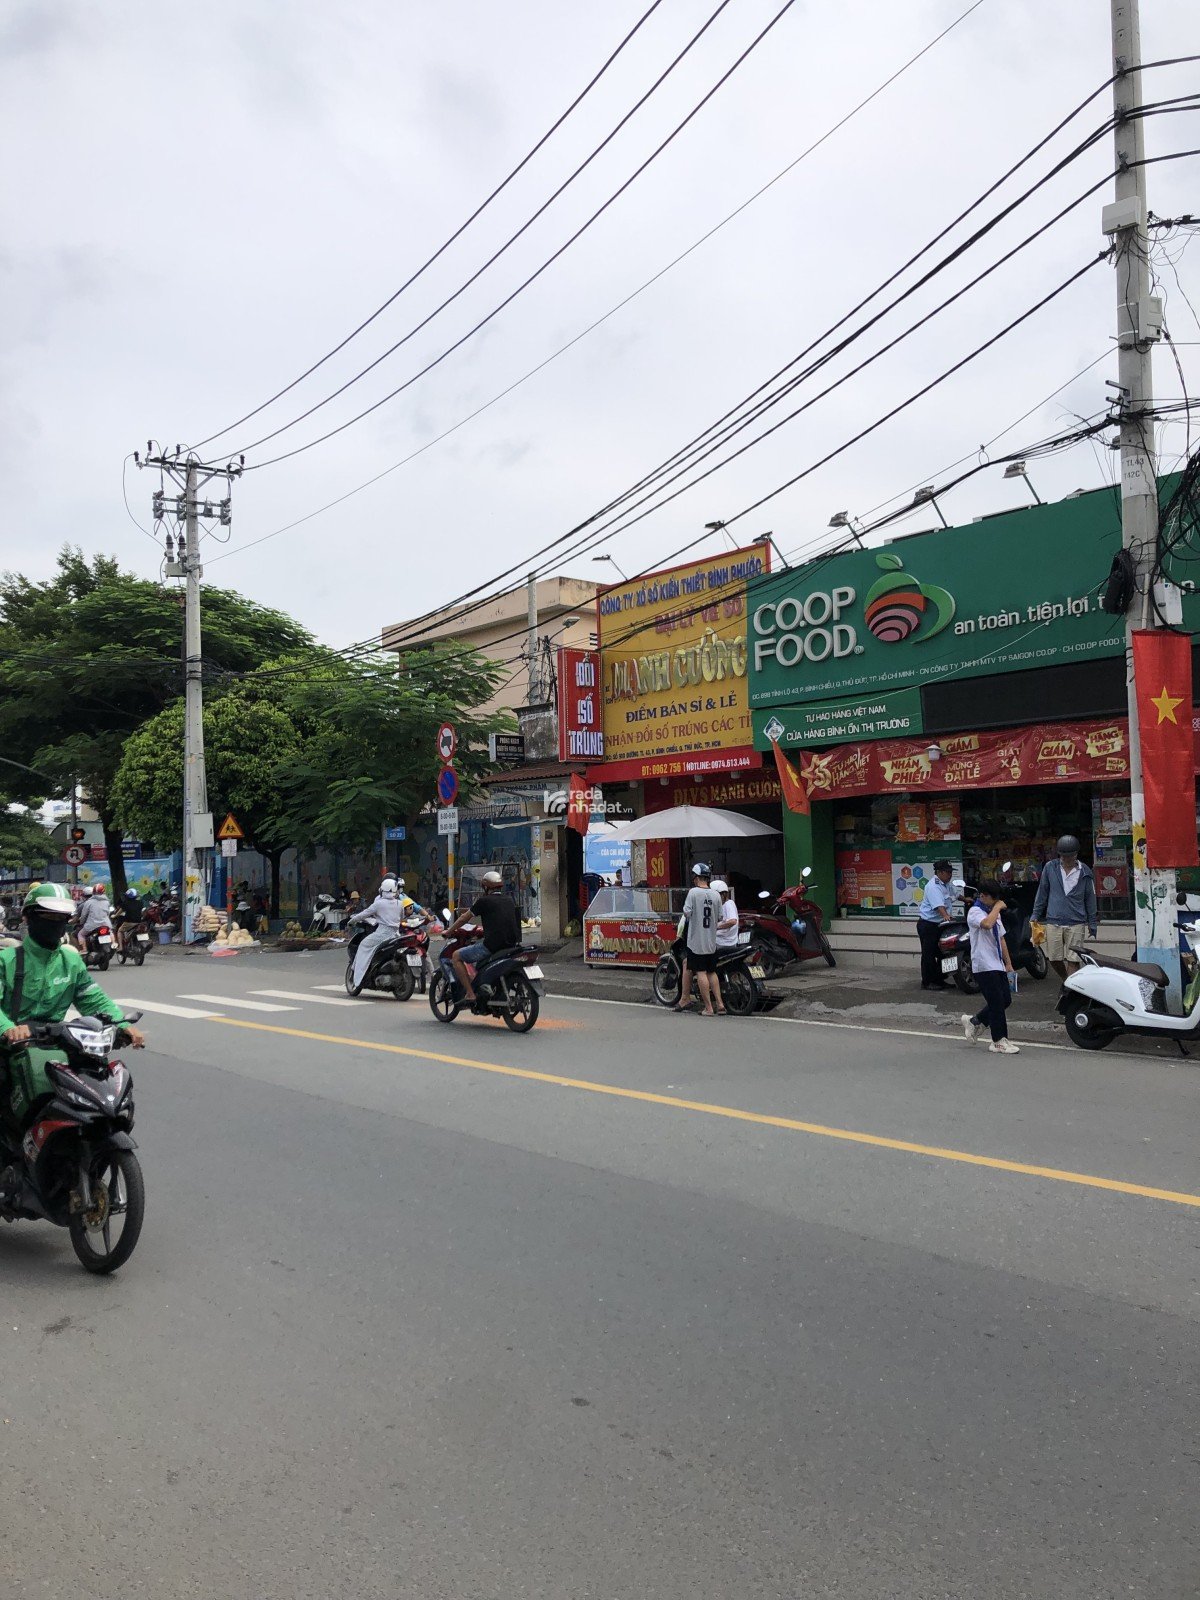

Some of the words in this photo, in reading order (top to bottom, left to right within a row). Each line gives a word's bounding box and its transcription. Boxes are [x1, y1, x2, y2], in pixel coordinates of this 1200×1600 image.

[600, 595, 621, 616] CÔNG
[623, 593, 634, 610] TY
[636, 580, 647, 606] XỔ
[648, 578, 660, 603] SỐ
[660, 575, 680, 600] KIẾN
[681, 568, 706, 593] THIẾT
[708, 566, 728, 588] BÌNH
[731, 555, 763, 580] PHƯỚC
[753, 586, 856, 636] CO.OP
[955, 620, 974, 635] an
[1027, 602, 1063, 626] tiện
[674, 627, 748, 688] CƯỜNG
[898, 669, 915, 679] MINH
[930, 663, 949, 673] CÔNG
[981, 657, 996, 665] MTV
[1008, 651, 1035, 661] SAIGON
[1062, 644, 1074, 653] CH
[1098, 637, 1120, 647] FOOD
[578, 692, 594, 724] SỐ
[626, 703, 657, 723] ĐIỂM
[660, 700, 688, 717] BÁN
[690, 695, 702, 713] SỈ
[705, 697, 716, 710] &
[720, 690, 738, 708] LẺ
[805, 714, 815, 723] TỰ
[815, 711, 831, 722] HÀO
[831, 708, 852, 720] HÀNG
[853, 705, 868, 717] VIỆT
[868, 705, 886, 715] NAM
[569, 726, 604, 756] TRÚNG
[606, 732, 634, 748] NHẬN
[636, 724, 653, 743] ĐỔI
[655, 722, 670, 740] SỐ
[672, 718, 709, 738] TRÚNG
[711, 714, 735, 732] CÁC
[786, 729, 803, 741] CỬA
[804, 727, 826, 739] HÀNG
[828, 723, 846, 736] BÌNH
[848, 720, 861, 734] ỔN
[861, 723, 874, 733] THỊ
[876, 717, 910, 731] TRƯỜNG
[1090, 729, 1119, 744] HÀNG
[642, 765, 652, 776] ĐT:
[653, 764, 668, 775] 0962
[669, 763, 681, 774] 756
[891, 766, 931, 784] PHIẾU
[945, 770, 965, 784] ĐẠI
[967, 762, 980, 779] LỄ
[711, 783, 746, 803] MẠNH
[651, 850, 665, 877] SỐ
